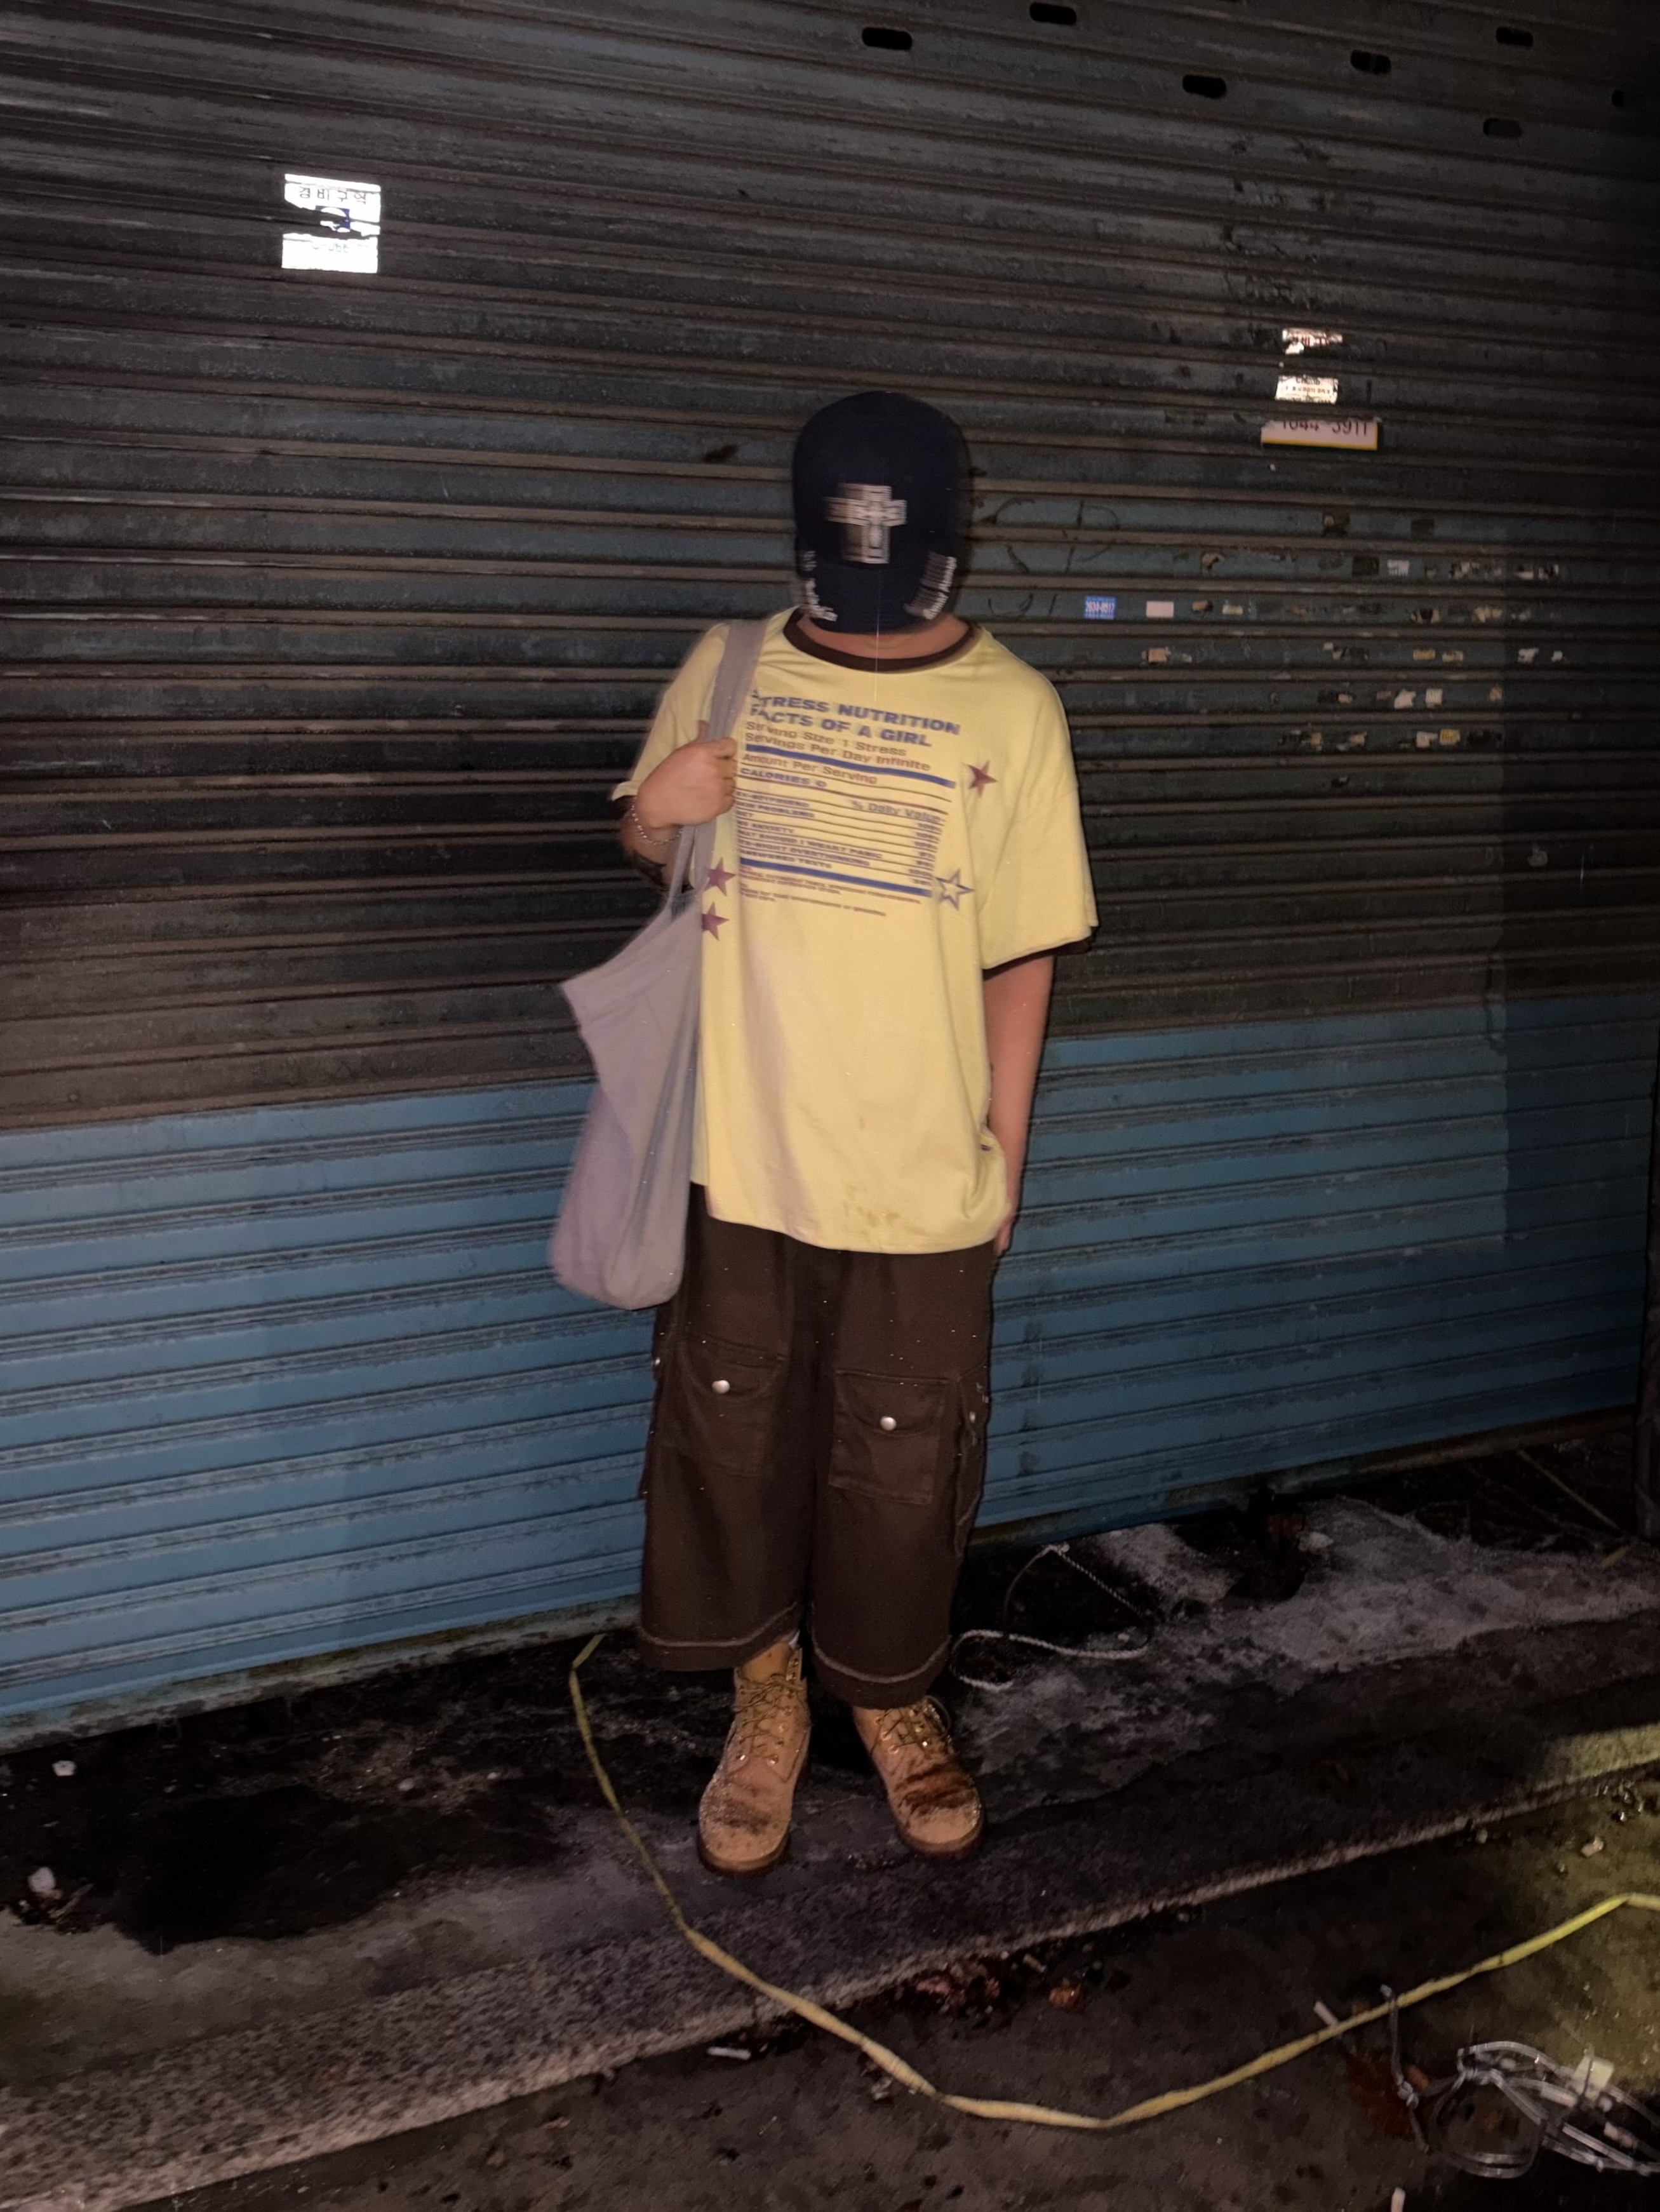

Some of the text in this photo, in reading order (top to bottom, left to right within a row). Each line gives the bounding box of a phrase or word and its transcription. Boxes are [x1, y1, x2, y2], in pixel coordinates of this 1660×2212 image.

[821, 719, 851, 732] OF
[858, 725, 872, 738] A
[880, 729, 932, 747] GIRL
[839, 704, 961, 735] NUTRITION
[745, 733, 931, 771] Servings Per Day Infinite
[804, 732, 835, 744] Size
[857, 742, 907, 756] Stress
[740, 767, 811, 785] CALORIES
[742, 753, 878, 784] Amount Per Serving
